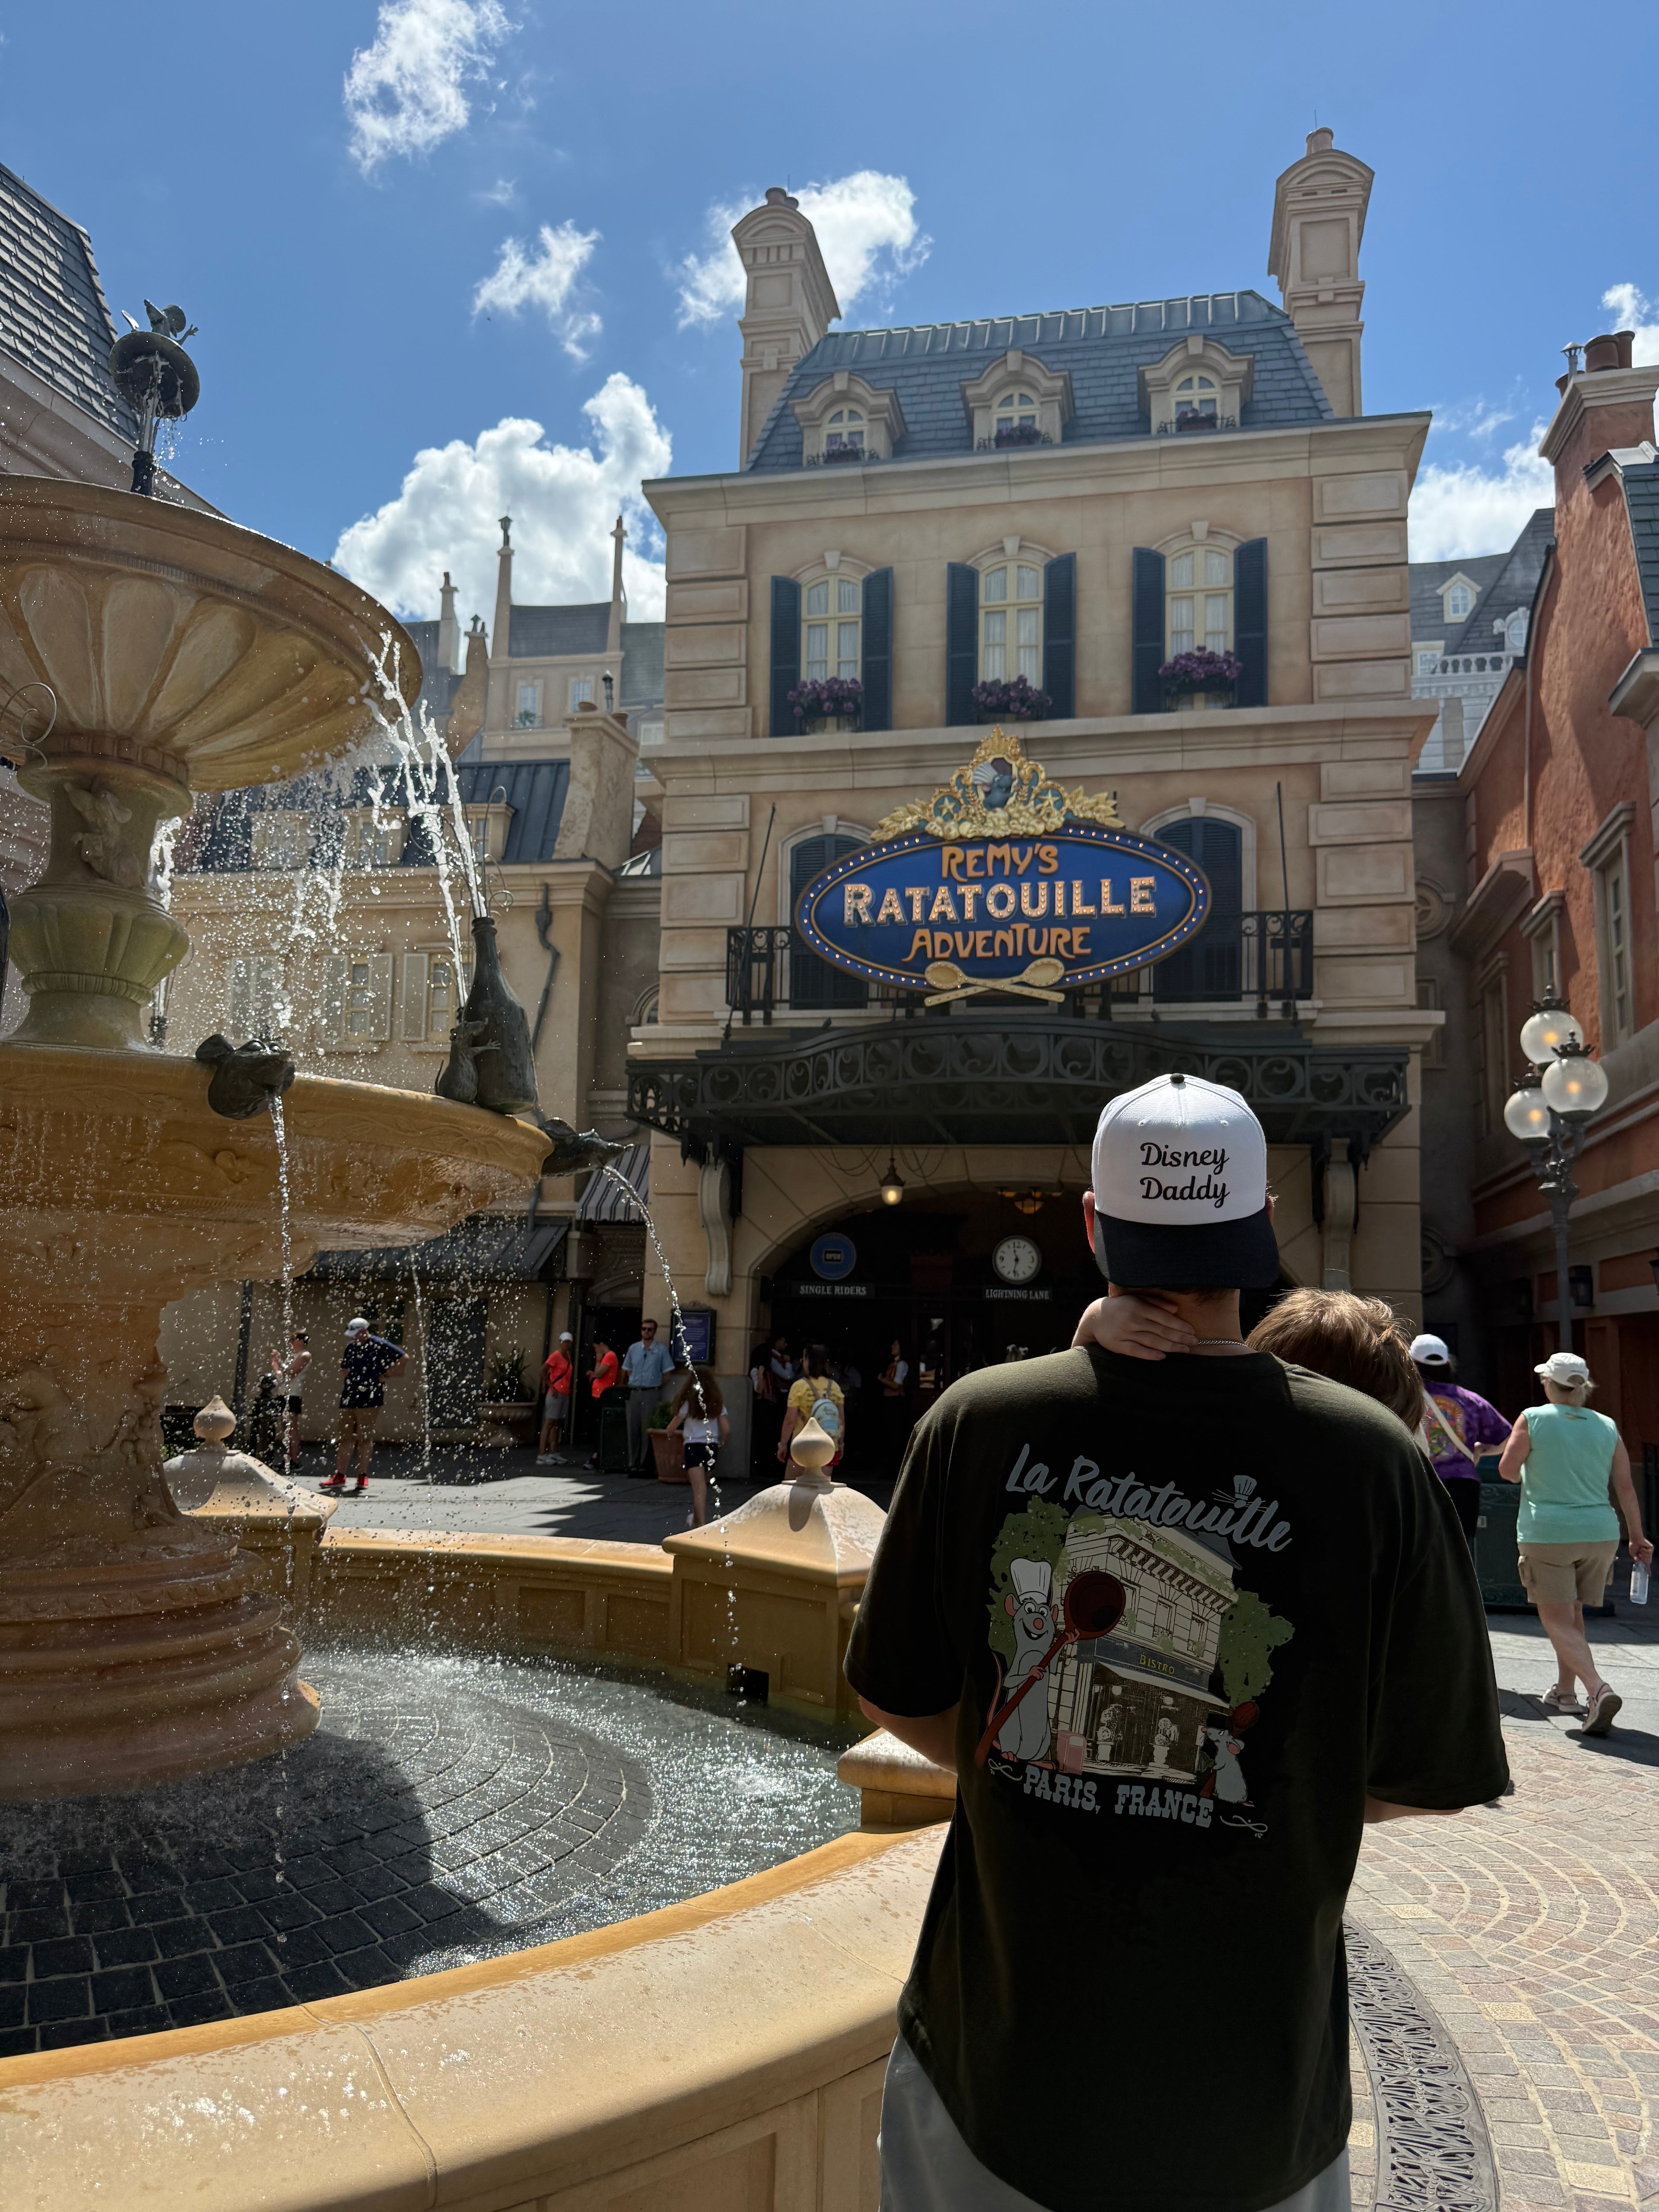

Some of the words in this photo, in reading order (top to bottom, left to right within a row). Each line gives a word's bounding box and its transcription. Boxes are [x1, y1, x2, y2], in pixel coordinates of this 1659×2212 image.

[941, 843, 1058, 882] REMY'S
[843, 876, 1157, 927] RATATOUILLE
[901, 923, 1092, 962] ADVENTURE
[1140, 1142, 1230, 1175] Disney
[1140, 1174, 1230, 1208] Daddy
[799, 1284, 832, 1295] SINGLE
[834, 1285, 867, 1296] RIDERS
[985, 1289, 1028, 1300] LIGHTNING
[1029, 1290, 1049, 1300] LANE
[1005, 1443, 1058, 1494] La
[1064, 1455, 1293, 1552] Ratatouille
[1139, 1653, 1175, 1675] BISTRO
[1023, 1764, 1100, 1815] PARIS,
[1114, 1784, 1214, 1828] FRANCE
